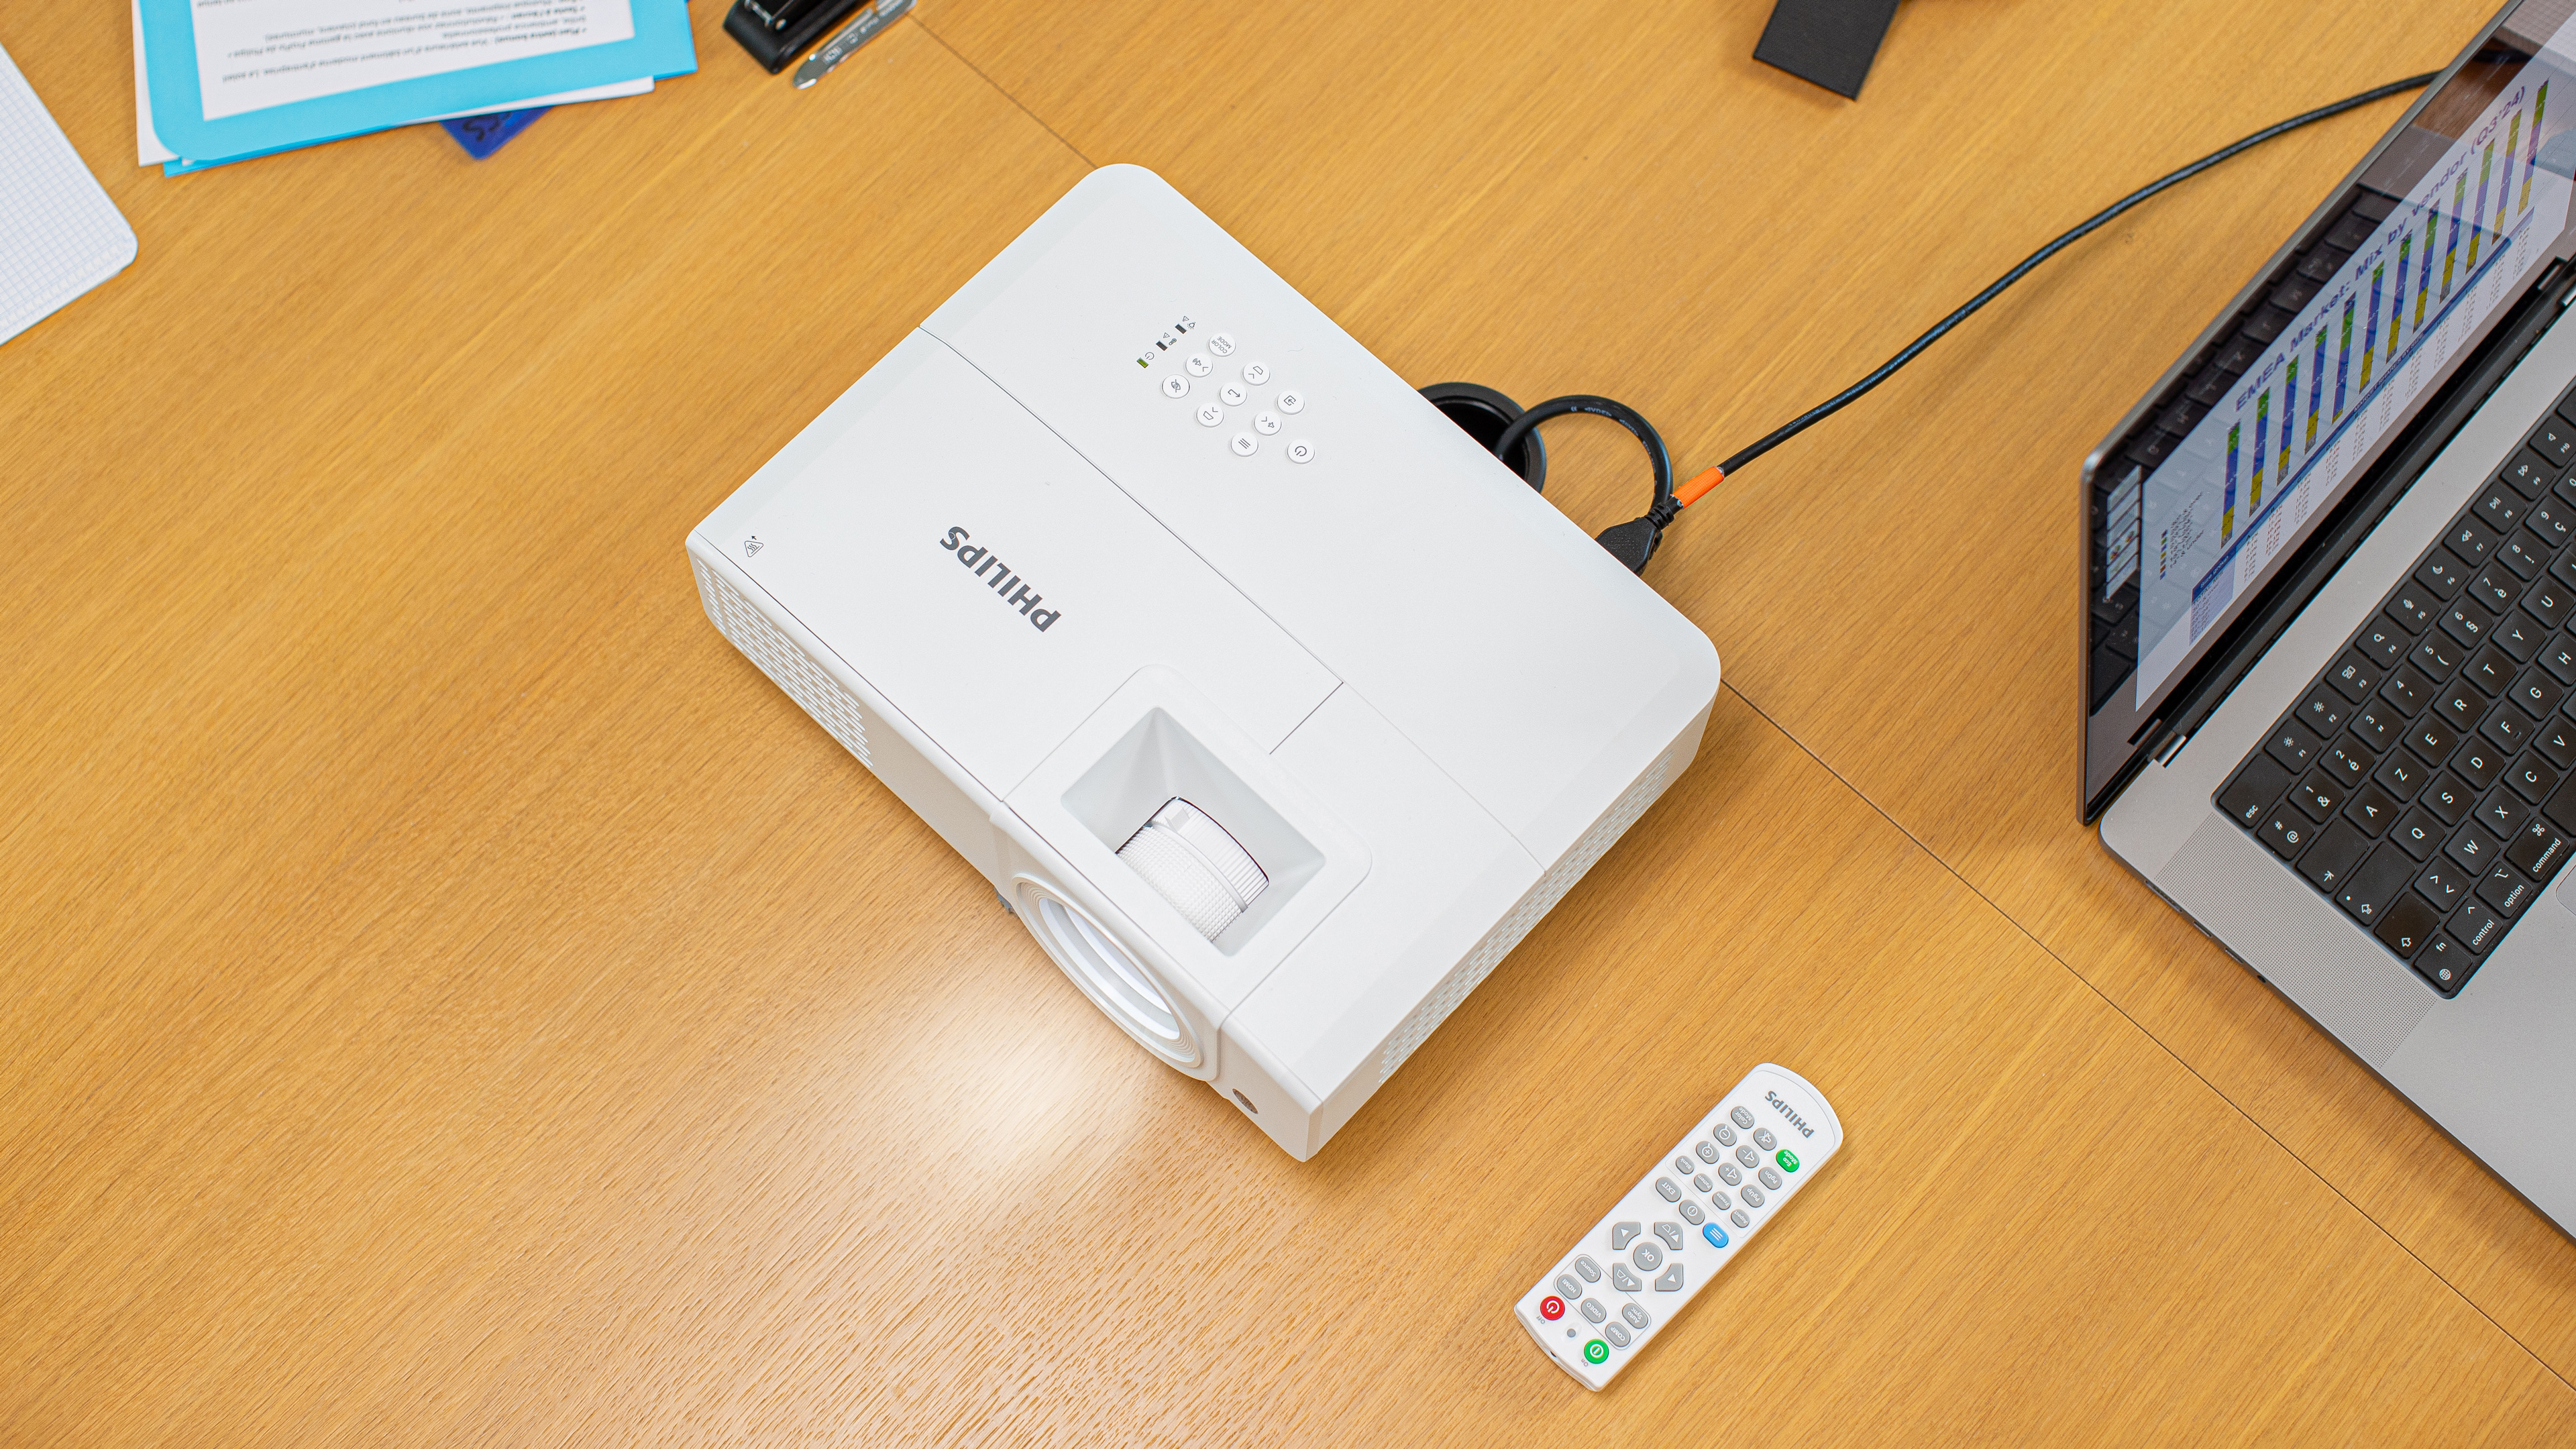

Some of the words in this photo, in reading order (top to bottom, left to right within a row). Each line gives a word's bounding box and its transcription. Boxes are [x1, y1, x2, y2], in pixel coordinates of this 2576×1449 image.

[2236, 352, 2286, 413] EMEA
[2290, 281, 2350, 350] Market:
[2355, 247, 2383, 281] Mix
[2387, 219, 2407, 245] by
[2412, 154, 2467, 217] vendor
[2471, 83, 2526, 155] (Q3'24)
[1211, 339, 1227, 354] COLOR
[1217, 335, 1232, 349] MODE
[2540, 511, 2549, 520] 9
[2555, 522, 2566, 533] ç
[2512, 544, 2521, 553] 8
[2524, 554, 2534, 564] !
[940, 526, 1061, 633] PHILIPS
[2483, 577, 2491, 586] 7
[2494, 588, 2507, 598] è
[2540, 595, 2553, 608] U
[2455, 611, 2463, 621] 6
[2465, 621, 2479, 633] §
[2512, 629, 2524, 641] Y
[2388, 644, 2397, 654] F4
[2424, 645, 2434, 655] 5
[2558, 651, 2571, 665] H
[2483, 663, 2495, 675] T
[2359, 679, 2367, 688] F3
[2396, 680, 2405, 689] 4
[2530, 687, 2542, 698] G
[2454, 698, 2467, 711] R
[2328, 714, 2337, 722] F2
[2365, 715, 2375, 724] 3
[2501, 721, 2511, 733] F
[2424, 733, 2438, 746] E
[2553, 735, 2566, 747] V
[2298, 749, 2306, 757] F1
[2335, 750, 2345, 759] 2
[2348, 759, 2359, 771] é
[2471, 757, 2483, 769] D
[2394, 767, 2408, 781] Z
[2525, 771, 2537, 783] C
[2317, 796, 2330, 807] &
[2441, 792, 2454, 804] S
[2245, 805, 2259, 818] esc
[2365, 806, 2378, 817] A
[2495, 806, 2509, 818] X
[2274, 820, 2283, 830] #
[2286, 830, 2299, 843] @
[2412, 828, 2425, 839] Q
[2463, 840, 2479, 855] W
[2532, 837, 2561, 872] command
[2504, 884, 2525, 908] option
[2472, 919, 2495, 946] control
[2436, 941, 2447, 952] fn
[1733, 1110, 1748, 1125] Color
[1737, 1106, 1753, 1121] Mode
[1764, 1089, 1815, 1139] PHILIPS
[1679, 1157, 1692, 1169] Blank
[1781, 1156, 1792, 1167] Eco
[1782, 1149, 1798, 1165] Mode
[1696, 1173, 1711, 1189] Pattern
[1763, 1169, 1778, 1184] PgDn
[1661, 1180, 1676, 1195] EXIT
[1746, 1186, 1762, 1201] PgUp
[1715, 1191, 1729, 1206] Freeze
[1733, 1209, 1748, 1224] Aspect
[1641, 1248, 1656, 1263] OK
[1578, 1259, 1597, 1277] Source
[1561, 1277, 1577, 1293] HDMI
[1585, 1301, 1602, 1318] VIDEO
[1629, 1305, 1644, 1320] Sync
[1535, 1314, 1546, 1325] Off
[1626, 1310, 1640, 1324] Auto
[1609, 1325, 1626, 1342] COMP
[1579, 1357, 1589, 1367] On
